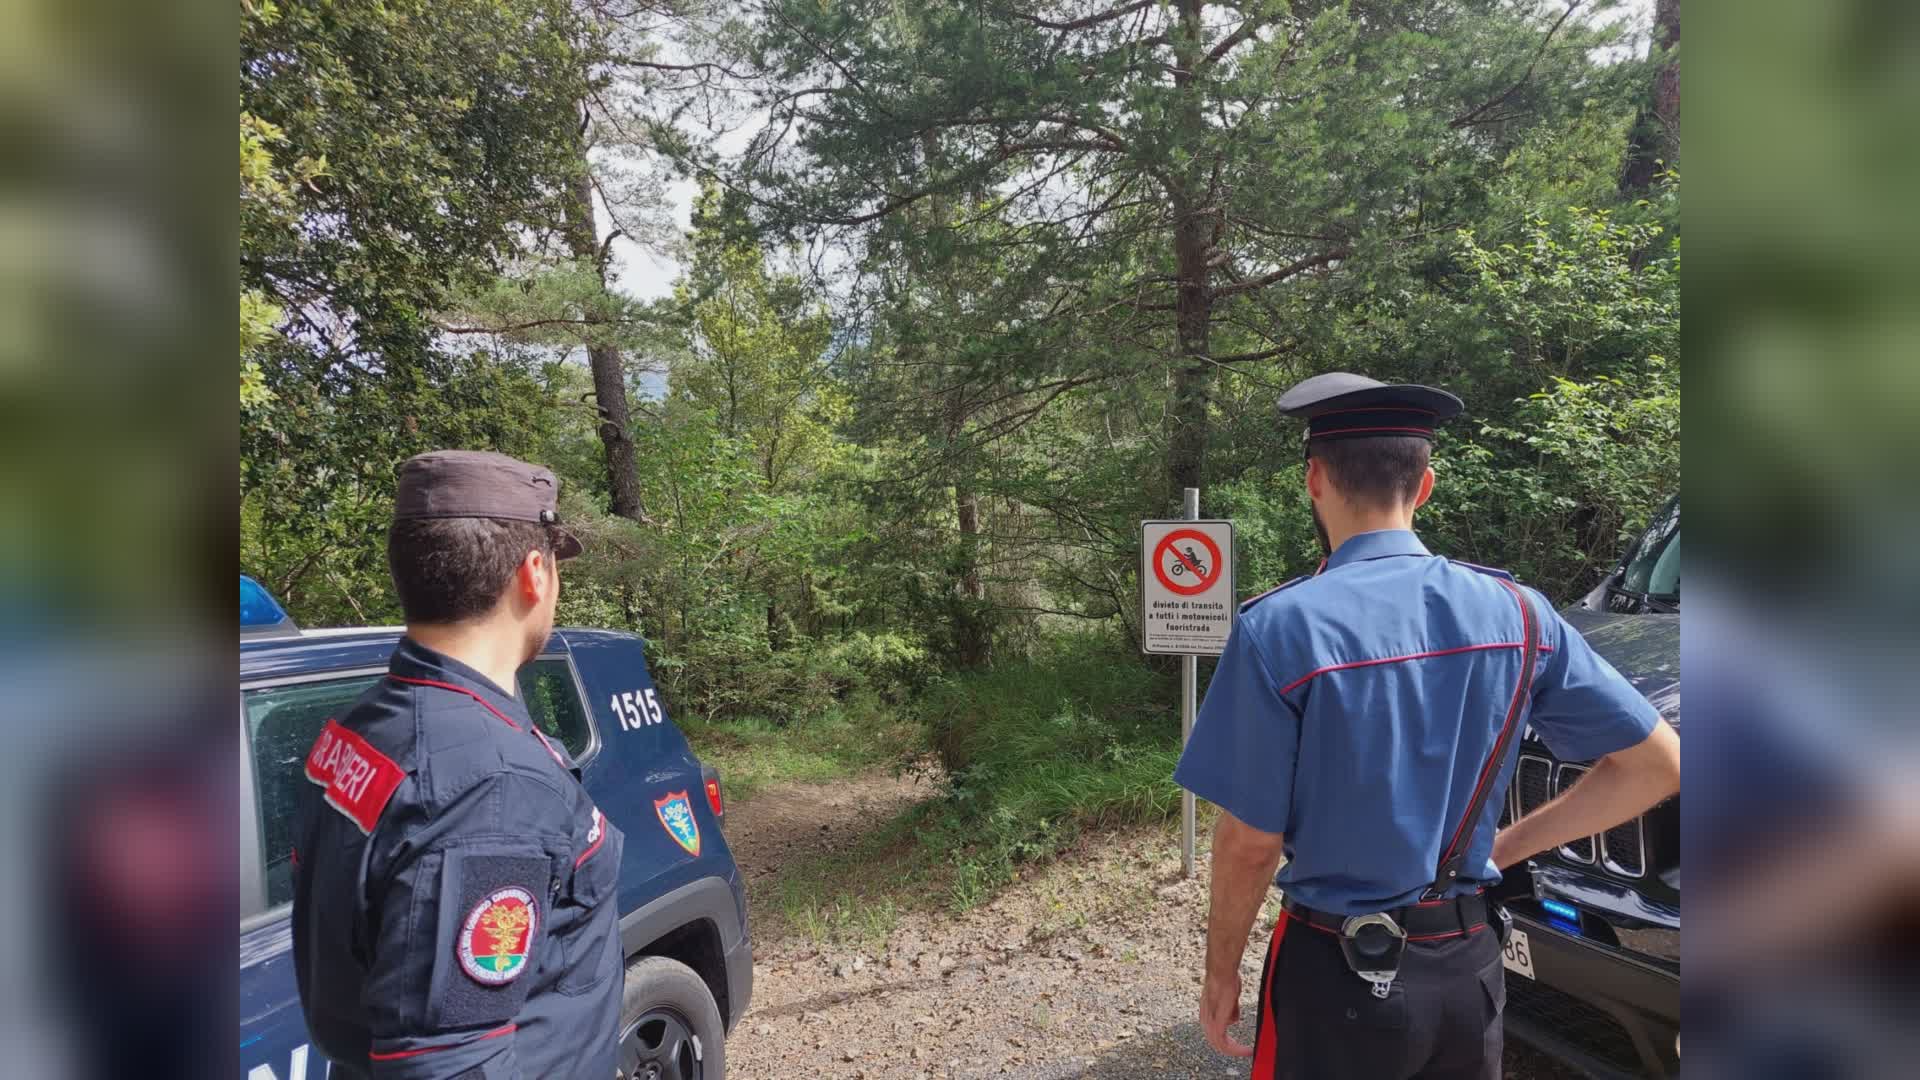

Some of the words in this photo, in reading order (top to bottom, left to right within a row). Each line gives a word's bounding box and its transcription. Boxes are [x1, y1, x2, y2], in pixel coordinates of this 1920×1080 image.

[1153, 600, 1179, 609] divieto
[1181, 600, 1189, 609] di
[1191, 601, 1224, 610] transito
[1156, 612, 1174, 620] tutti
[1181, 612, 1228, 621] motoveicoli
[1166, 623, 1210, 632] fuoristrada
[611, 688, 662, 731] 1515
[1504, 940, 1529, 968] 86
